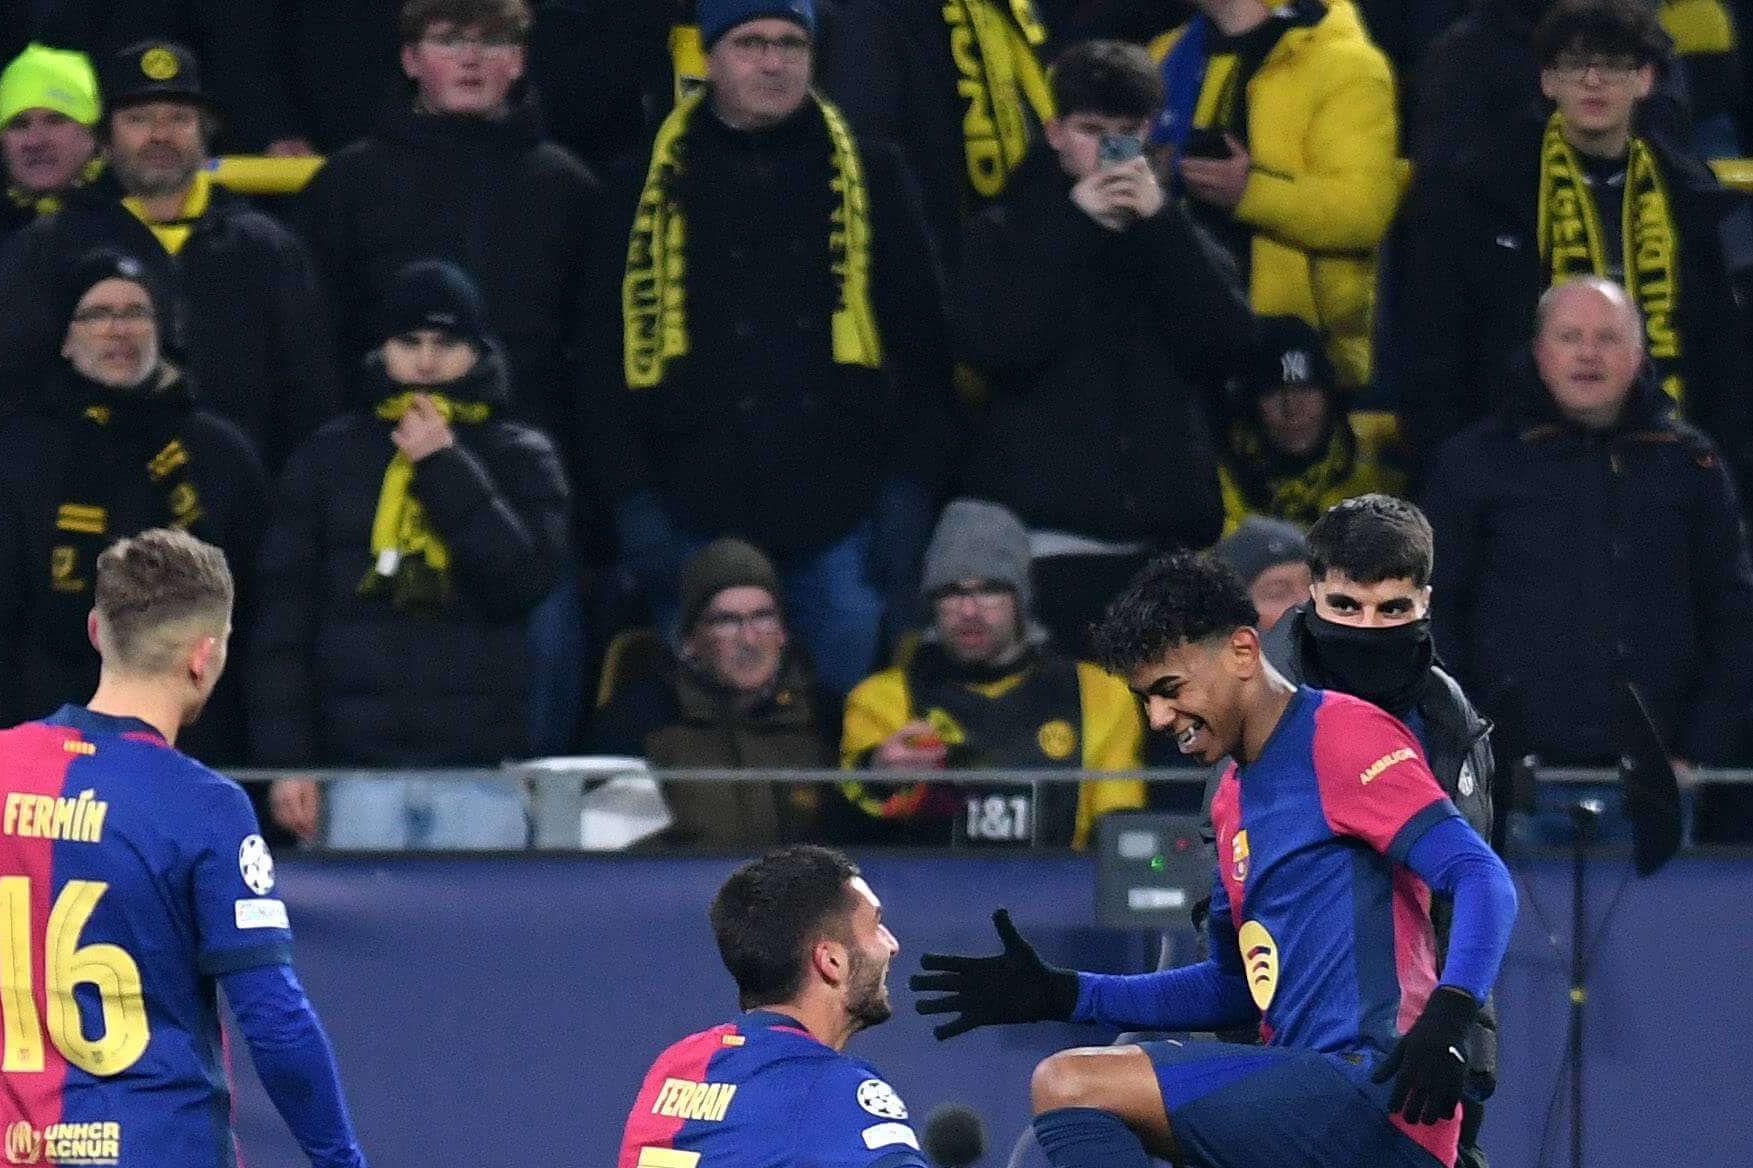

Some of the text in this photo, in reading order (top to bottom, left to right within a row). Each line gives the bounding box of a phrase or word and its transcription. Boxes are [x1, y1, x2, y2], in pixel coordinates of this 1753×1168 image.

[3, 788, 107, 843] FERMÍN
[967, 795, 1025, 838] 1&1
[651, 1077, 738, 1121] FERRAN
[44, 1122, 120, 1140] UNHCR
[45, 1140, 119, 1158] ACNUR
